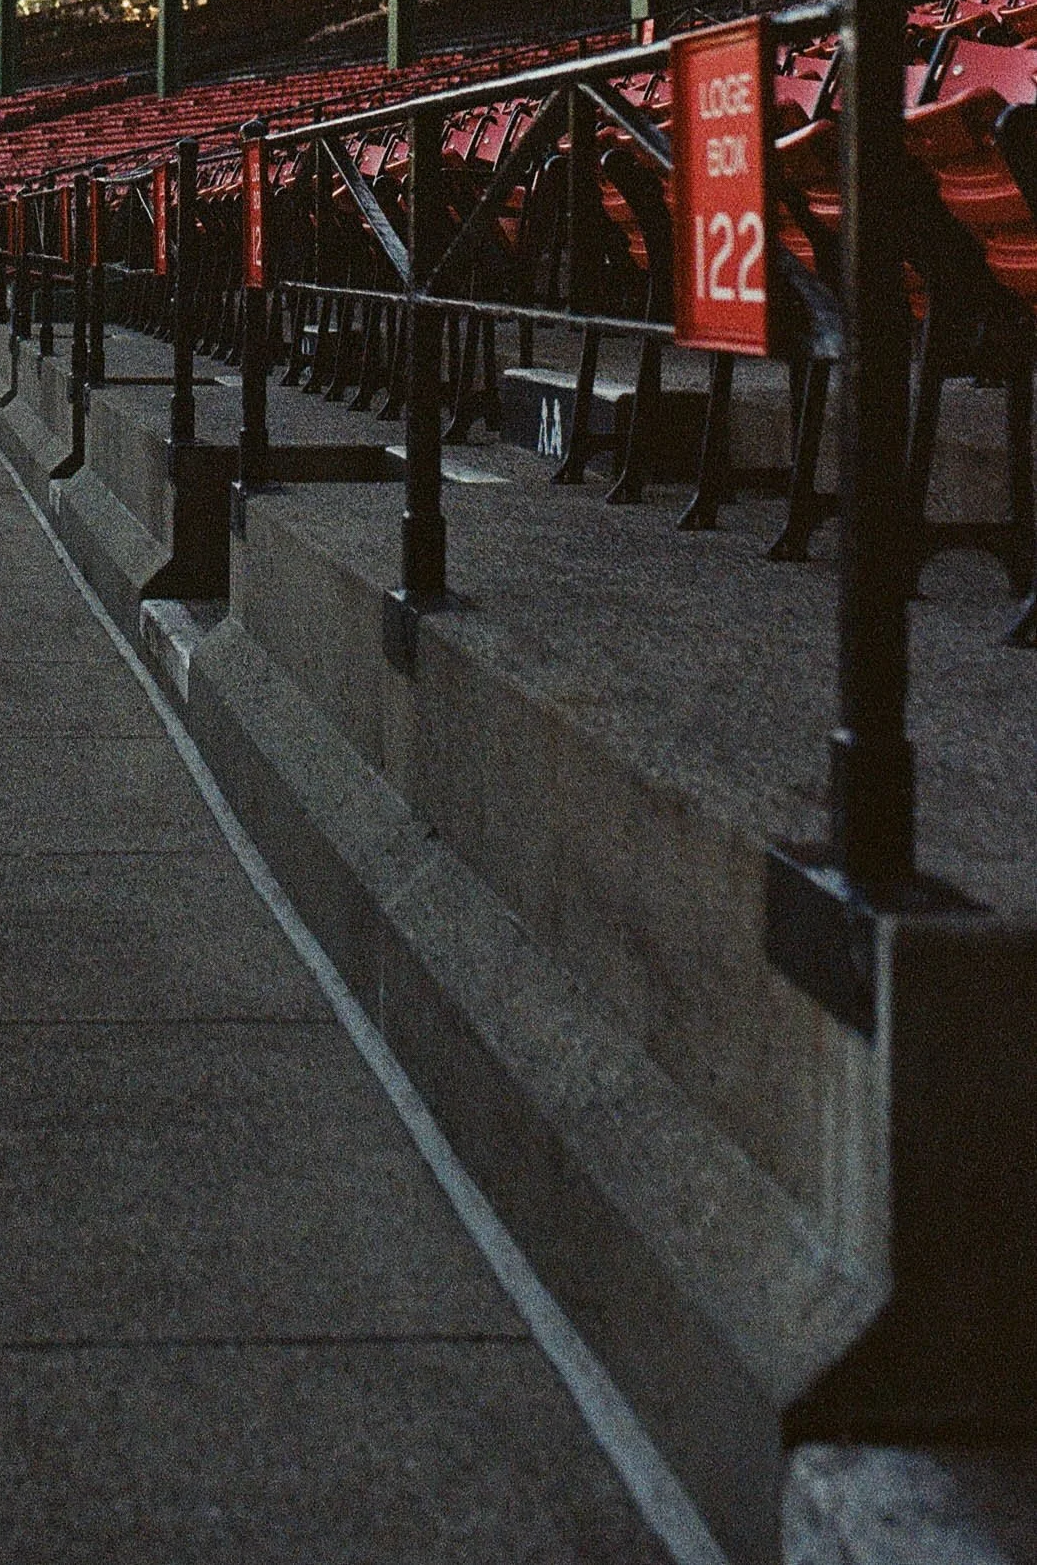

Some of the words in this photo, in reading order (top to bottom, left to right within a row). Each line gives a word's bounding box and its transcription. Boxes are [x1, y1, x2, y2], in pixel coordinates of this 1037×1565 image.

[699, 72, 754, 120] LOGE
[706, 136, 750, 177] BOX
[695, 210, 766, 303] 122
